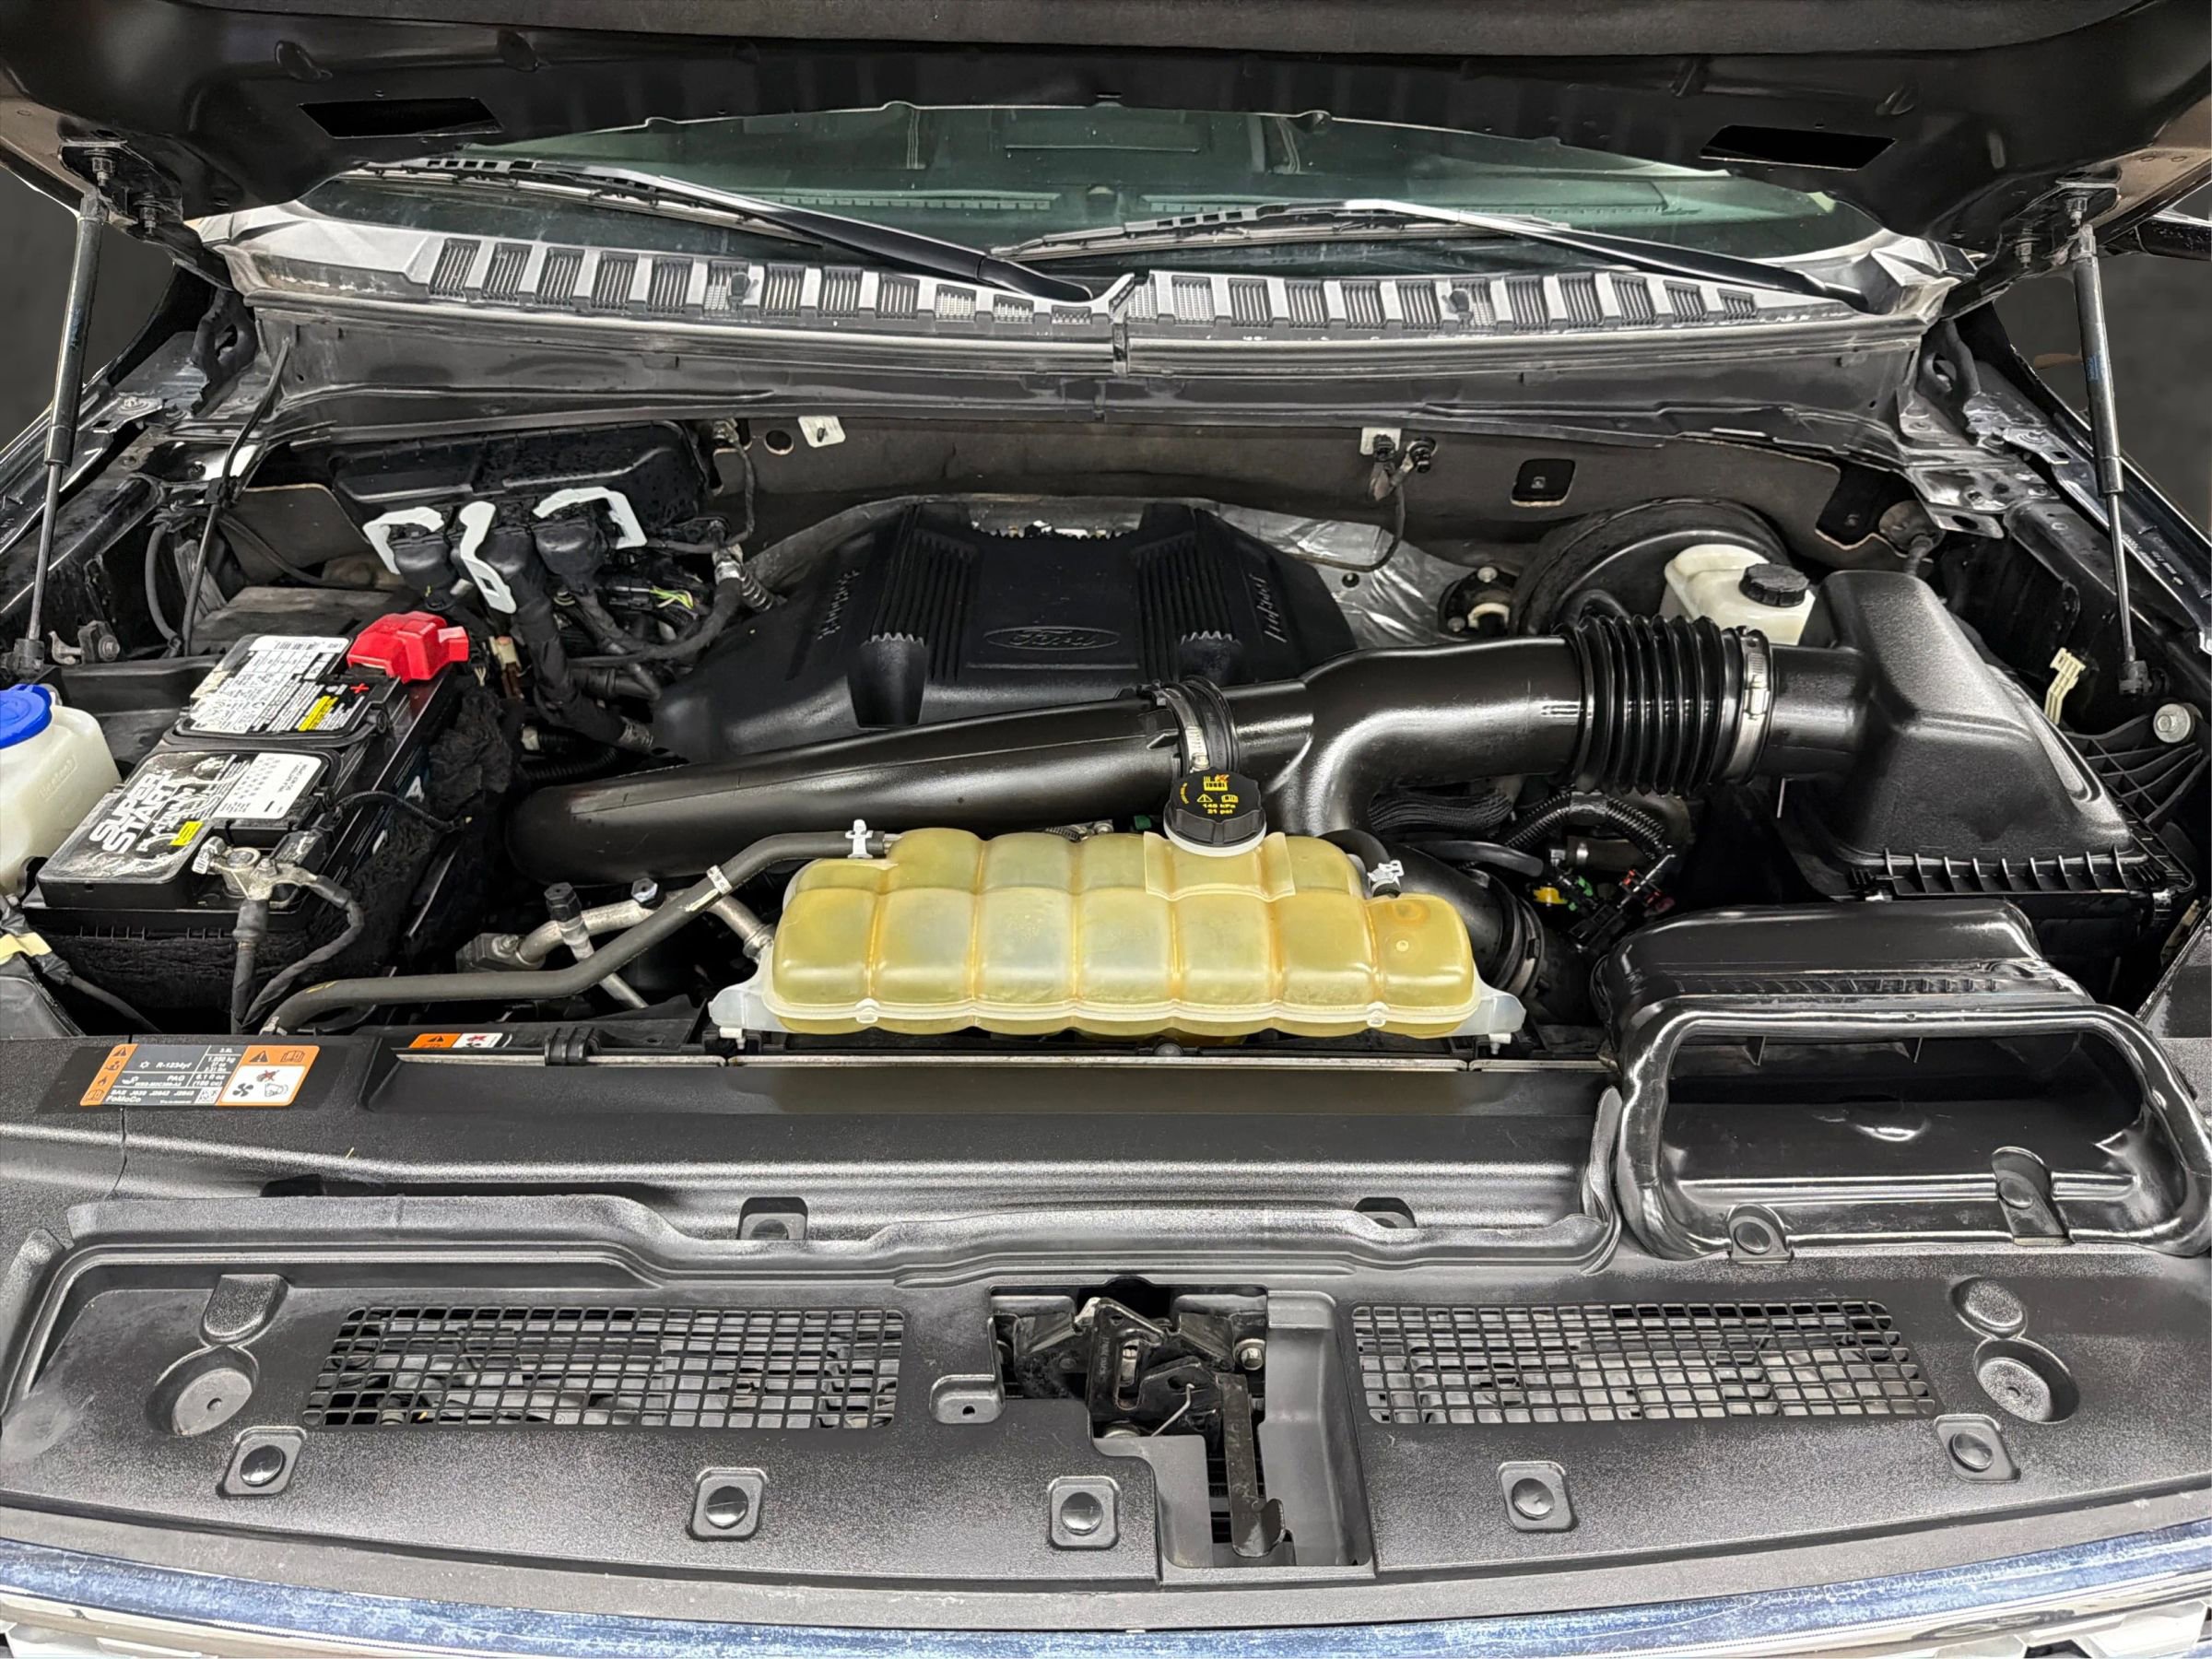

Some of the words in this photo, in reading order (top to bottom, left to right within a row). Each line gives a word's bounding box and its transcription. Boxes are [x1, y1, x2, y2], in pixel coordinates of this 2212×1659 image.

[1009, 629, 1097, 646] Ford
[88, 772, 160, 843] SUPER
[101, 772, 174, 854] START
[155, 1061, 193, 1070] R-1234yf
[105, 1095, 142, 1103] FoMoCo
